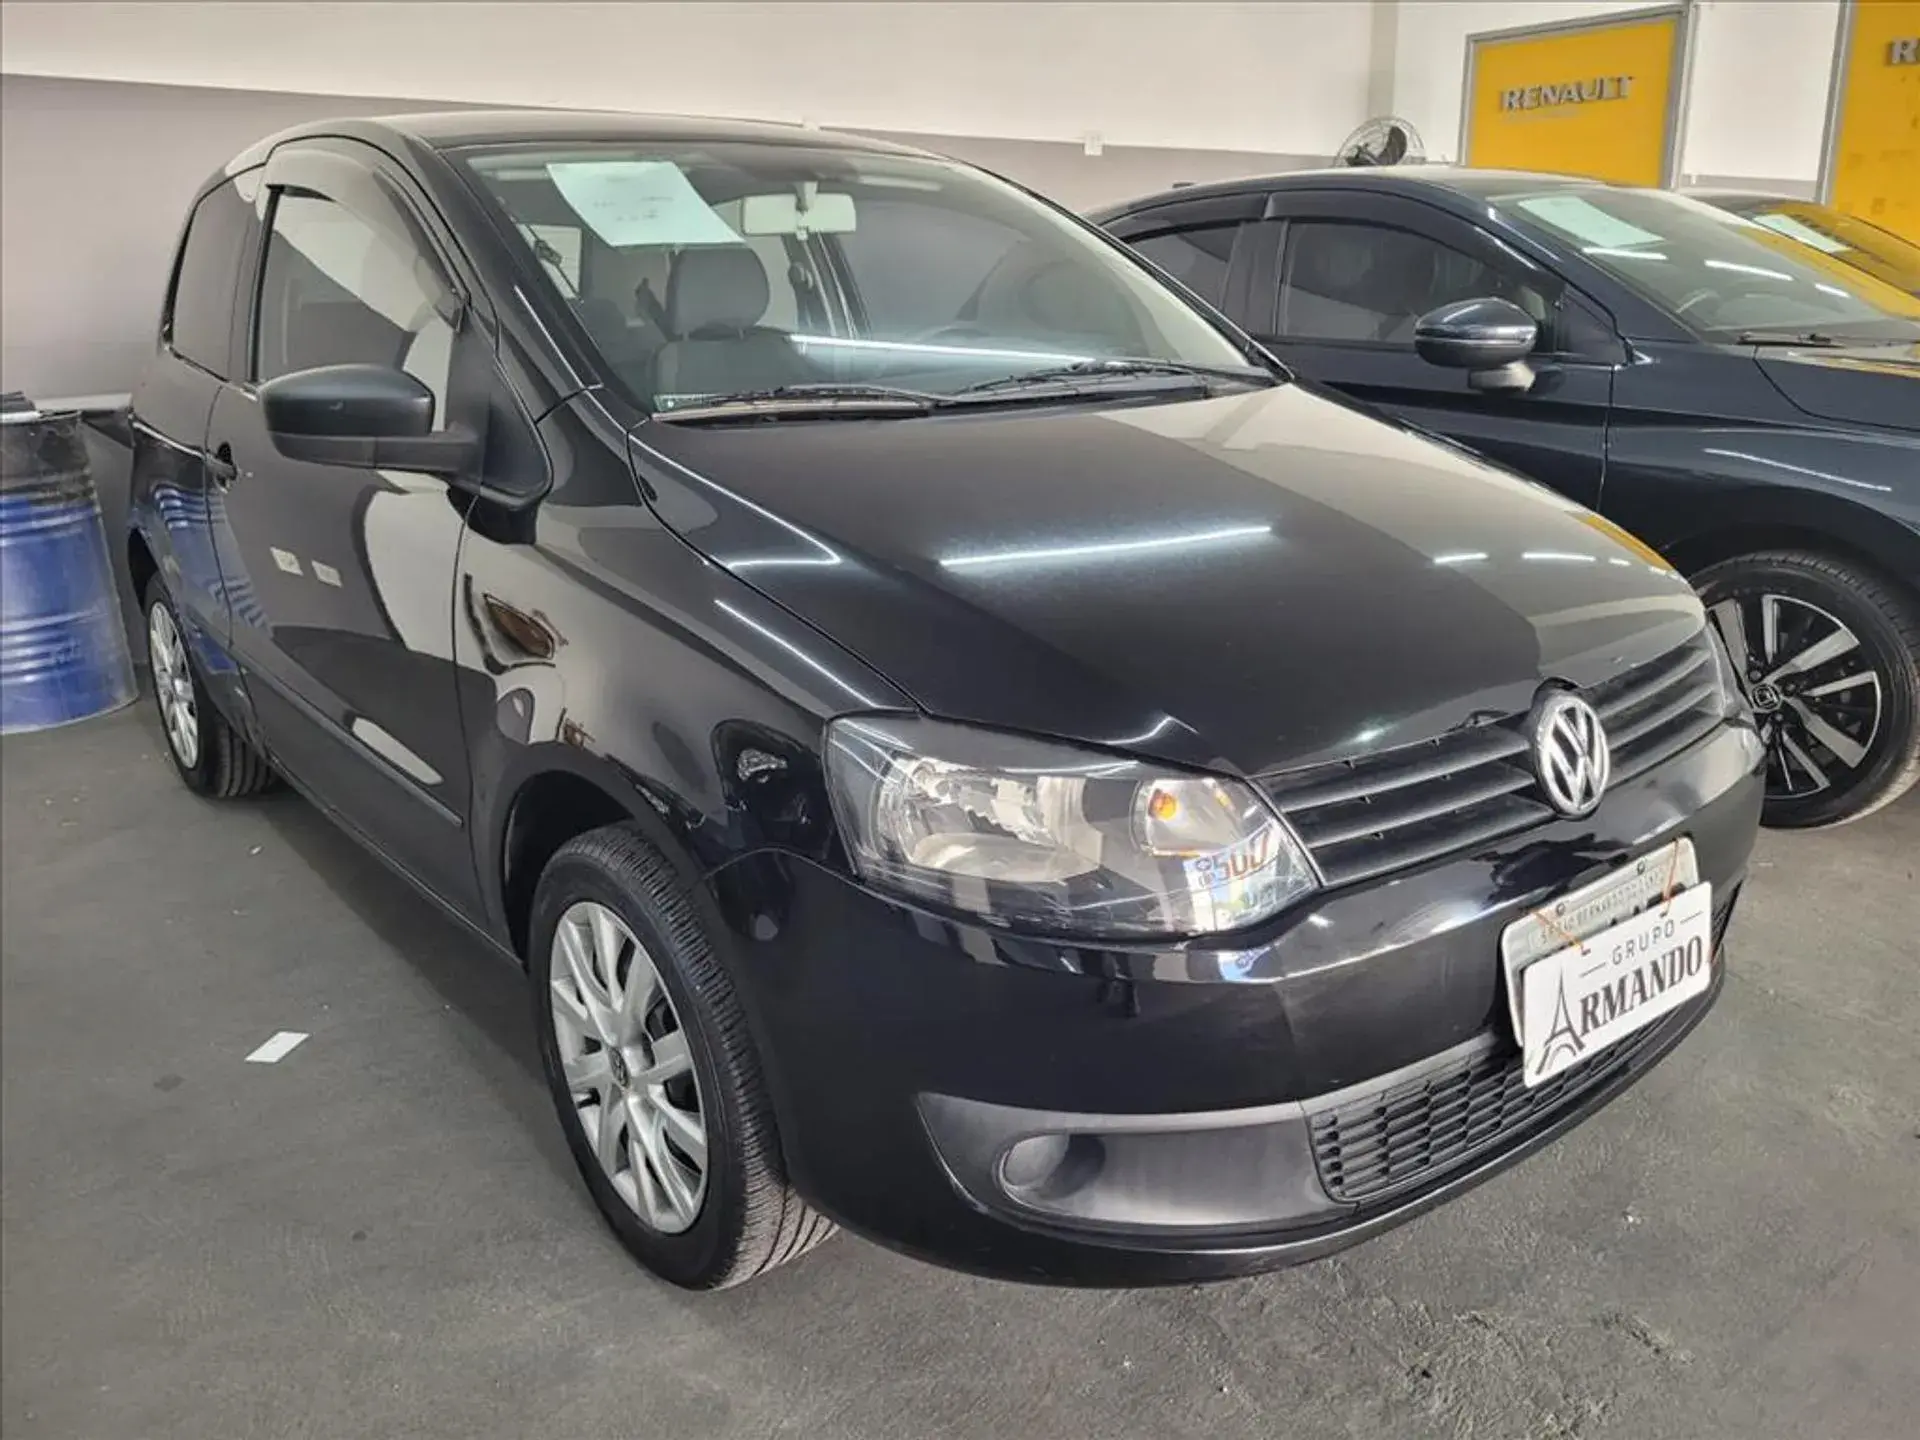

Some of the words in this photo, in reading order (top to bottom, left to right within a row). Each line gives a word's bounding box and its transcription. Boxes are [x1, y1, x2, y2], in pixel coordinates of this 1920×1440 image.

[1500, 74, 1634, 112] RENAULT
[1612, 919, 1675, 965] GRUPO
[1535, 935, 1702, 1076] ARMANDO
